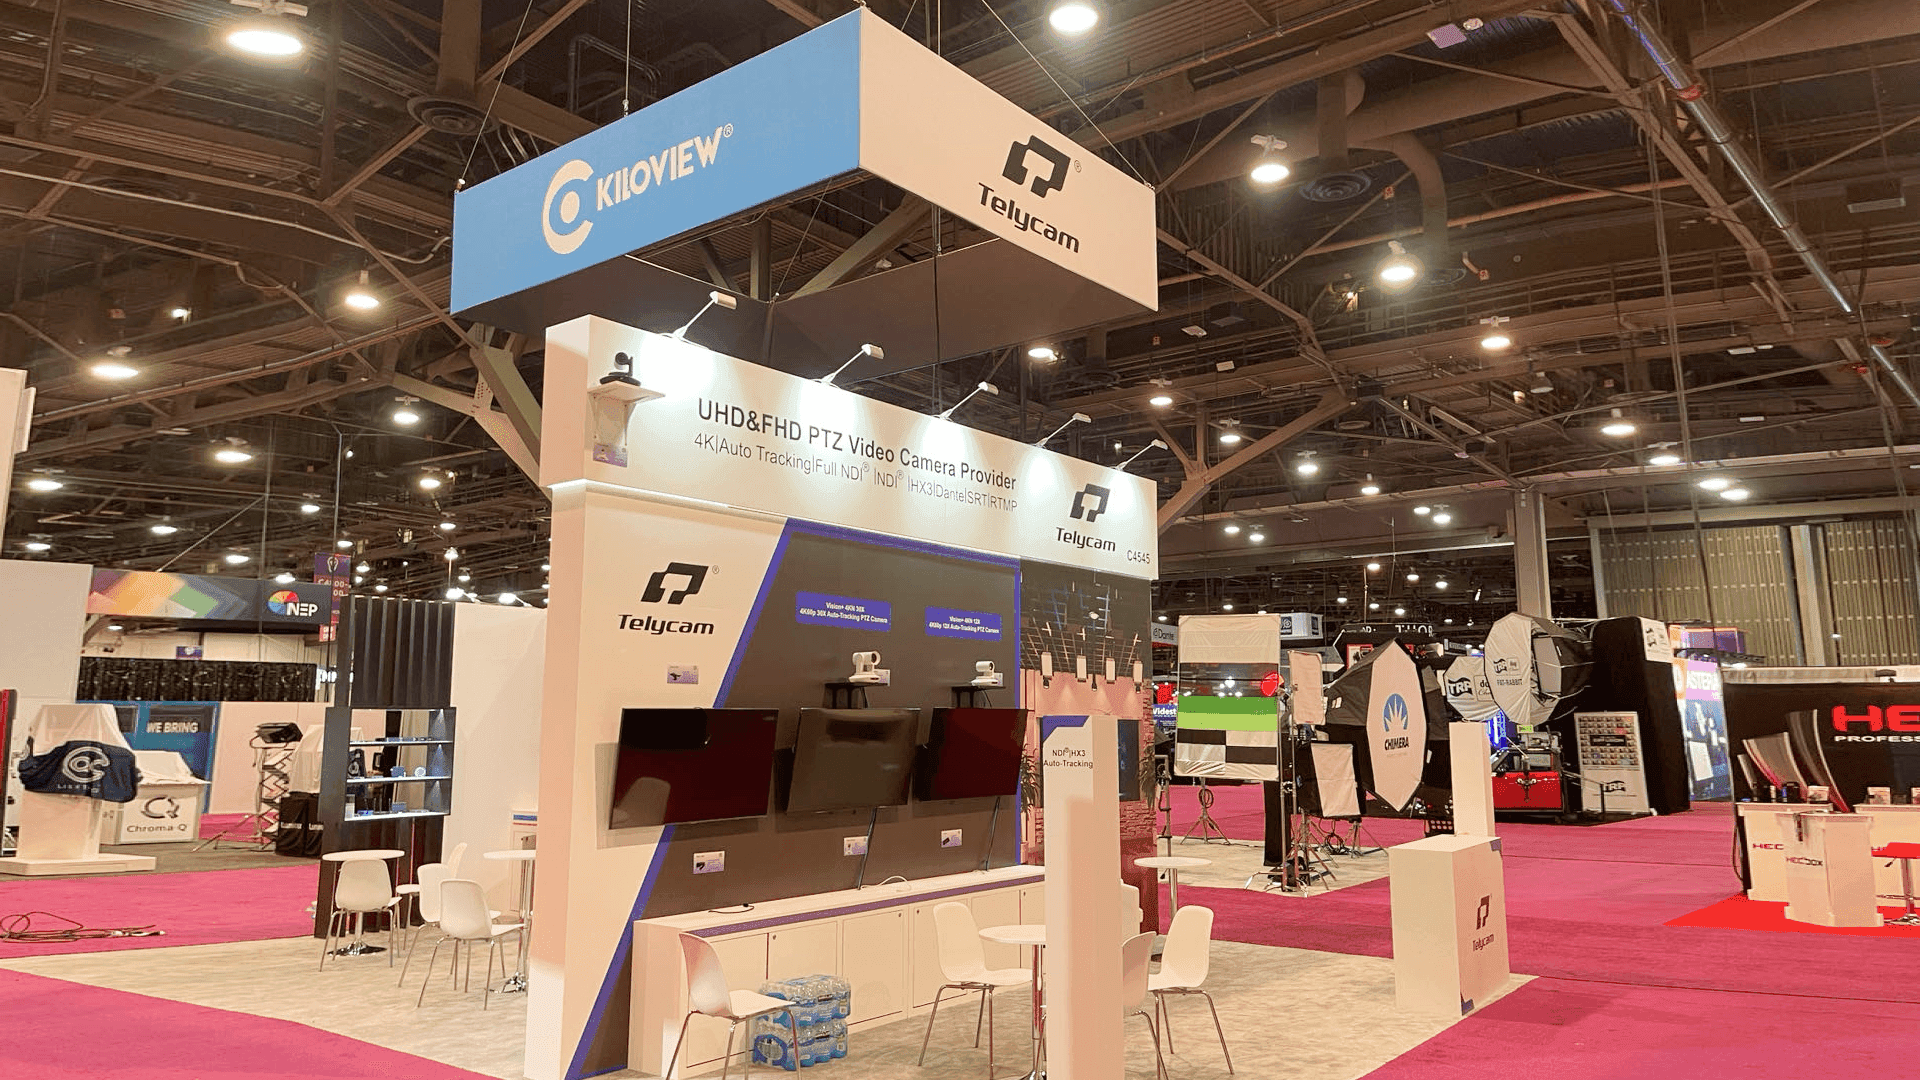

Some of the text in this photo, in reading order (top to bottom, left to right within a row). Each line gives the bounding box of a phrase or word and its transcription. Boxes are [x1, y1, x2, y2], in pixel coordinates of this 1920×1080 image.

[978, 182, 1080, 254] Telycam
[698, 397, 1017, 490] UHD&FHD PTZ Video Camera Provider
[1056, 526, 1116, 552] Telycam
[1126, 549, 1151, 564] C4545
[286, 601, 319, 617] NEP
[827, 611, 860, 622] Auto-Tracking
[860, 614, 870, 622] PTZ
[618, 613, 715, 636] Telycam
[163, 722, 198, 733] BRING
[1044, 760, 1094, 769] Auto-Tracking
